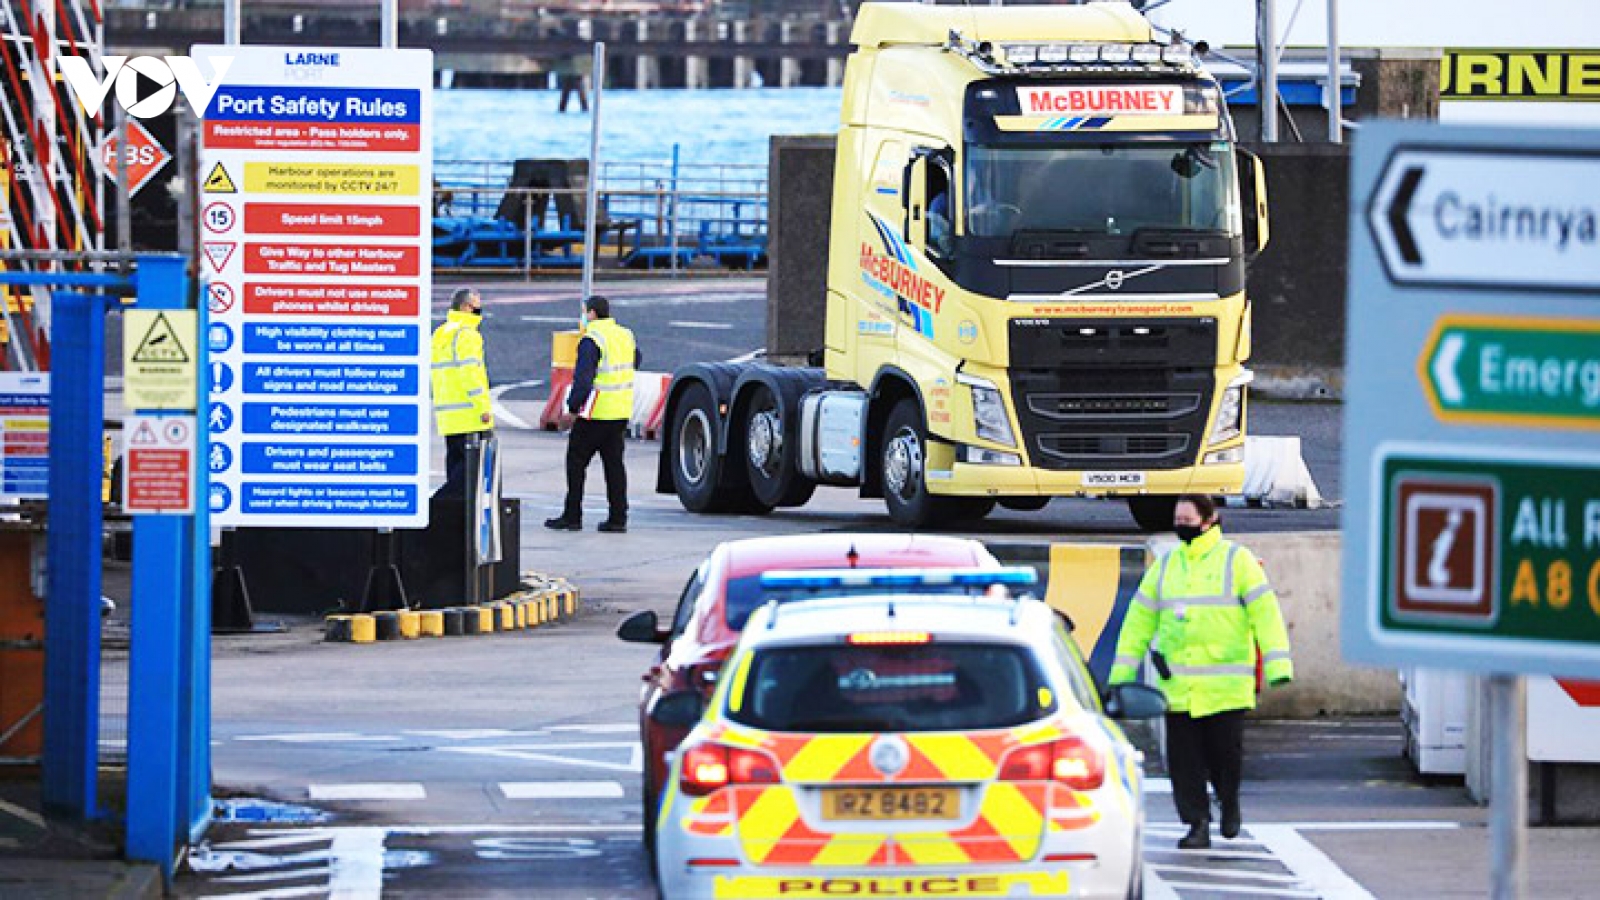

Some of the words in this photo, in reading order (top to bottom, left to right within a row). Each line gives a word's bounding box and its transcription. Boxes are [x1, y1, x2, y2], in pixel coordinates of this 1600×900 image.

[285, 53, 340, 67] LARNE
[1440, 54, 1600, 95] RNE
[217, 95, 265, 114] Port
[270, 96, 341, 119] Safety
[345, 98, 407, 117] Rules
[1029, 90, 1174, 112] McBURNEY
[213, 125, 272, 137] Restricted
[275, 129, 300, 137] area
[309, 127, 338, 138] Pass
[340, 128, 381, 138] holders
[384, 129, 409, 140] only.
[268, 167, 313, 177] Harbour
[317, 169, 374, 180] operations
[266, 181, 321, 190] monitored
[324, 181, 336, 192] by
[340, 182, 371, 191] CCTV
[375, 181, 398, 192] 24/7
[210, 210, 228, 225] 15
[281, 213, 317, 225] Speed
[320, 213, 342, 224] limit
[346, 214, 383, 226] 15mph
[1433, 190, 1595, 252] Cairnrya
[260, 247, 285, 257] Give
[287, 247, 310, 260] Way
[313, 249, 324, 258] to
[327, 248, 356, 258] other
[359, 249, 404, 259] Harbour
[267, 259, 302, 271] Traffic
[305, 261, 326, 271] and
[328, 261, 349, 274] Tug
[351, 262, 396, 272] Masters
[859, 241, 946, 314] McBURNEY
[255, 286, 294, 297] Drivers
[297, 288, 325, 298] must
[328, 289, 344, 298] not
[348, 291, 369, 299] use
[371, 288, 408, 299] mobile
[273, 301, 314, 313] phones
[317, 301, 349, 312] whilst
[351, 302, 390, 314] driving
[256, 326, 282, 339] High
[285, 328, 328, 340] visibility
[331, 328, 376, 340] clothing
[378, 329, 406, 339] must
[277, 341, 291, 350] be
[295, 343, 322, 351] worn
[325, 342, 336, 351] at
[338, 341, 351, 351] all
[354, 342, 385, 352] times
[256, 366, 272, 377] All
[273, 367, 311, 377] drivers
[313, 368, 341, 378] must
[344, 368, 377, 378] follow
[380, 369, 405, 379] road
[263, 381, 293, 392] signs
[296, 381, 316, 391] and
[320, 381, 344, 391] road
[346, 382, 398, 393] markings
[270, 406, 336, 418] Pedestrians
[339, 408, 367, 418] must
[369, 410, 389, 418] use
[270, 421, 333, 433] designated
[335, 421, 389, 433] walkways
[265, 446, 304, 457] Drivers
[308, 447, 328, 457] and
[331, 449, 394, 460] passengers
[273, 460, 300, 470] must
[303, 462, 330, 470] wear
[333, 461, 356, 471] seat
[360, 461, 387, 471] belts
[252, 487, 286, 497] Hazard
[288, 488, 313, 499] lights
[315, 490, 325, 498] or
[327, 488, 366, 498] beacons
[368, 489, 392, 498] must
[394, 489, 405, 498] be
[249, 500, 273, 509] used
[275, 500, 300, 509] when
[302, 500, 333, 511] driving
[335, 500, 371, 511] through
[373, 500, 409, 510] harbour
[1511, 497, 1568, 548] All
[778, 877, 1000, 895] POLICE
